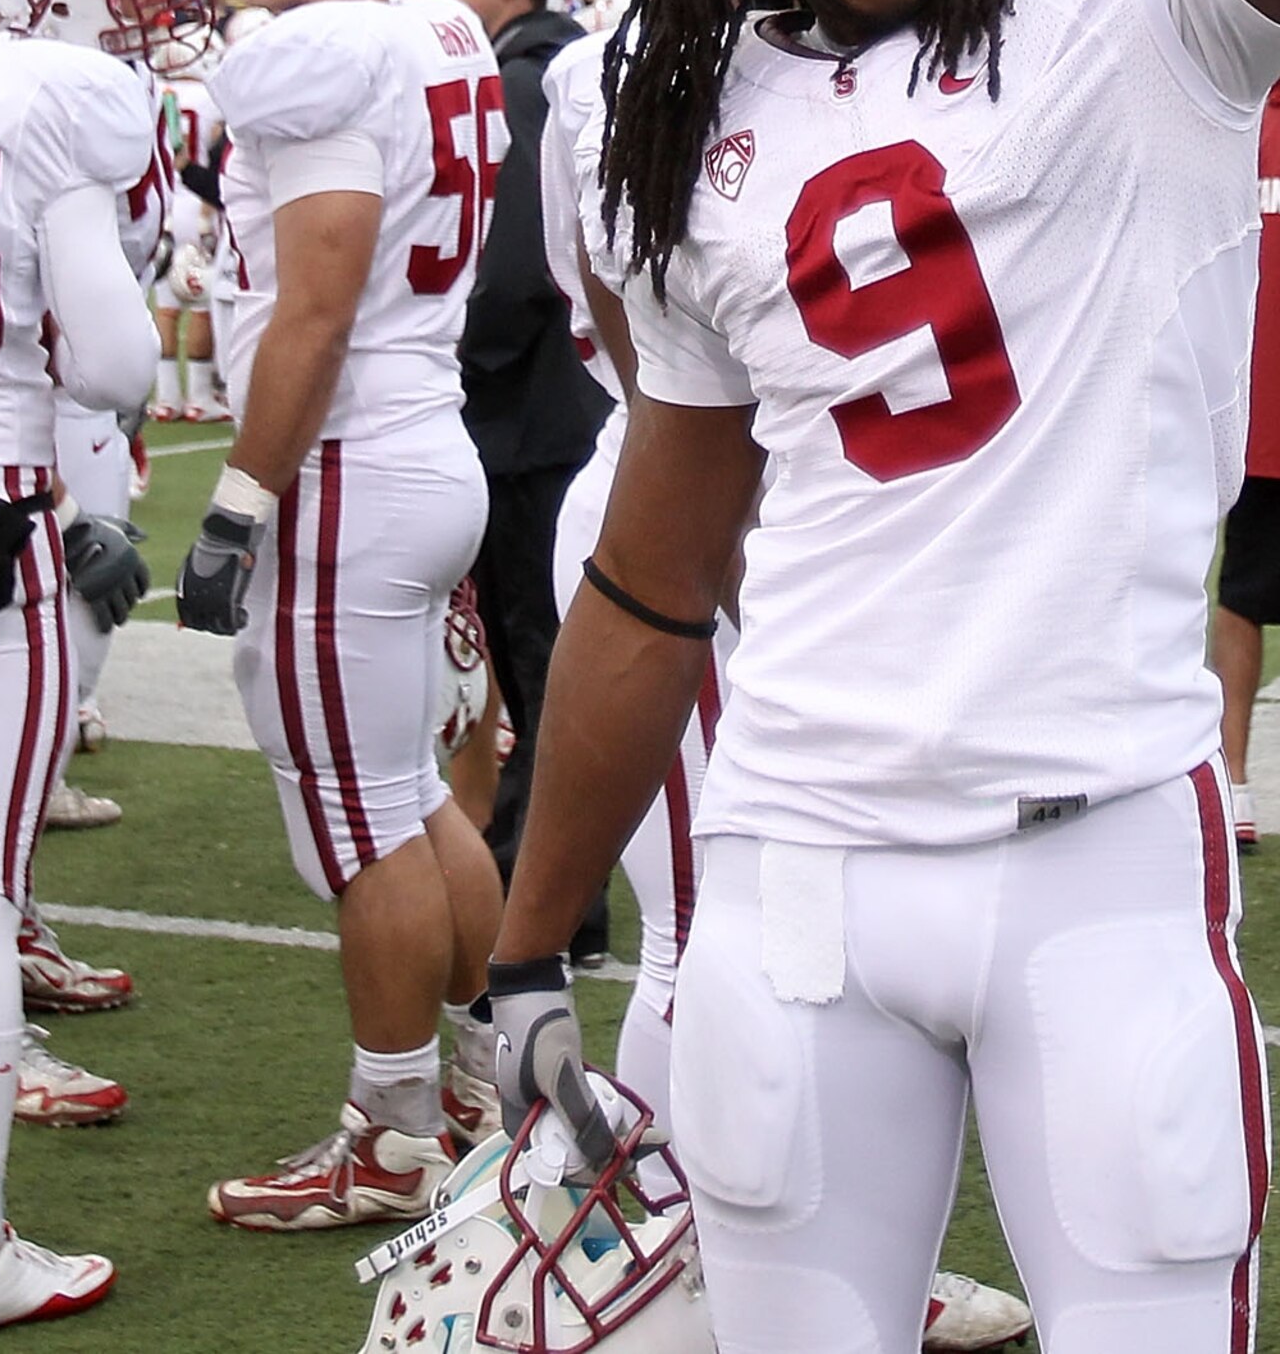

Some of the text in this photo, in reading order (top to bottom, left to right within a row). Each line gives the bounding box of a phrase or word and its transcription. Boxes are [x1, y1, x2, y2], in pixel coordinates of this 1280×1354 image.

[707, 132, 752, 179] PAC
[720, 160, 745, 192] 10
[784, 138, 1023, 484] 9
[386, 1211, 449, 1260] schutt
